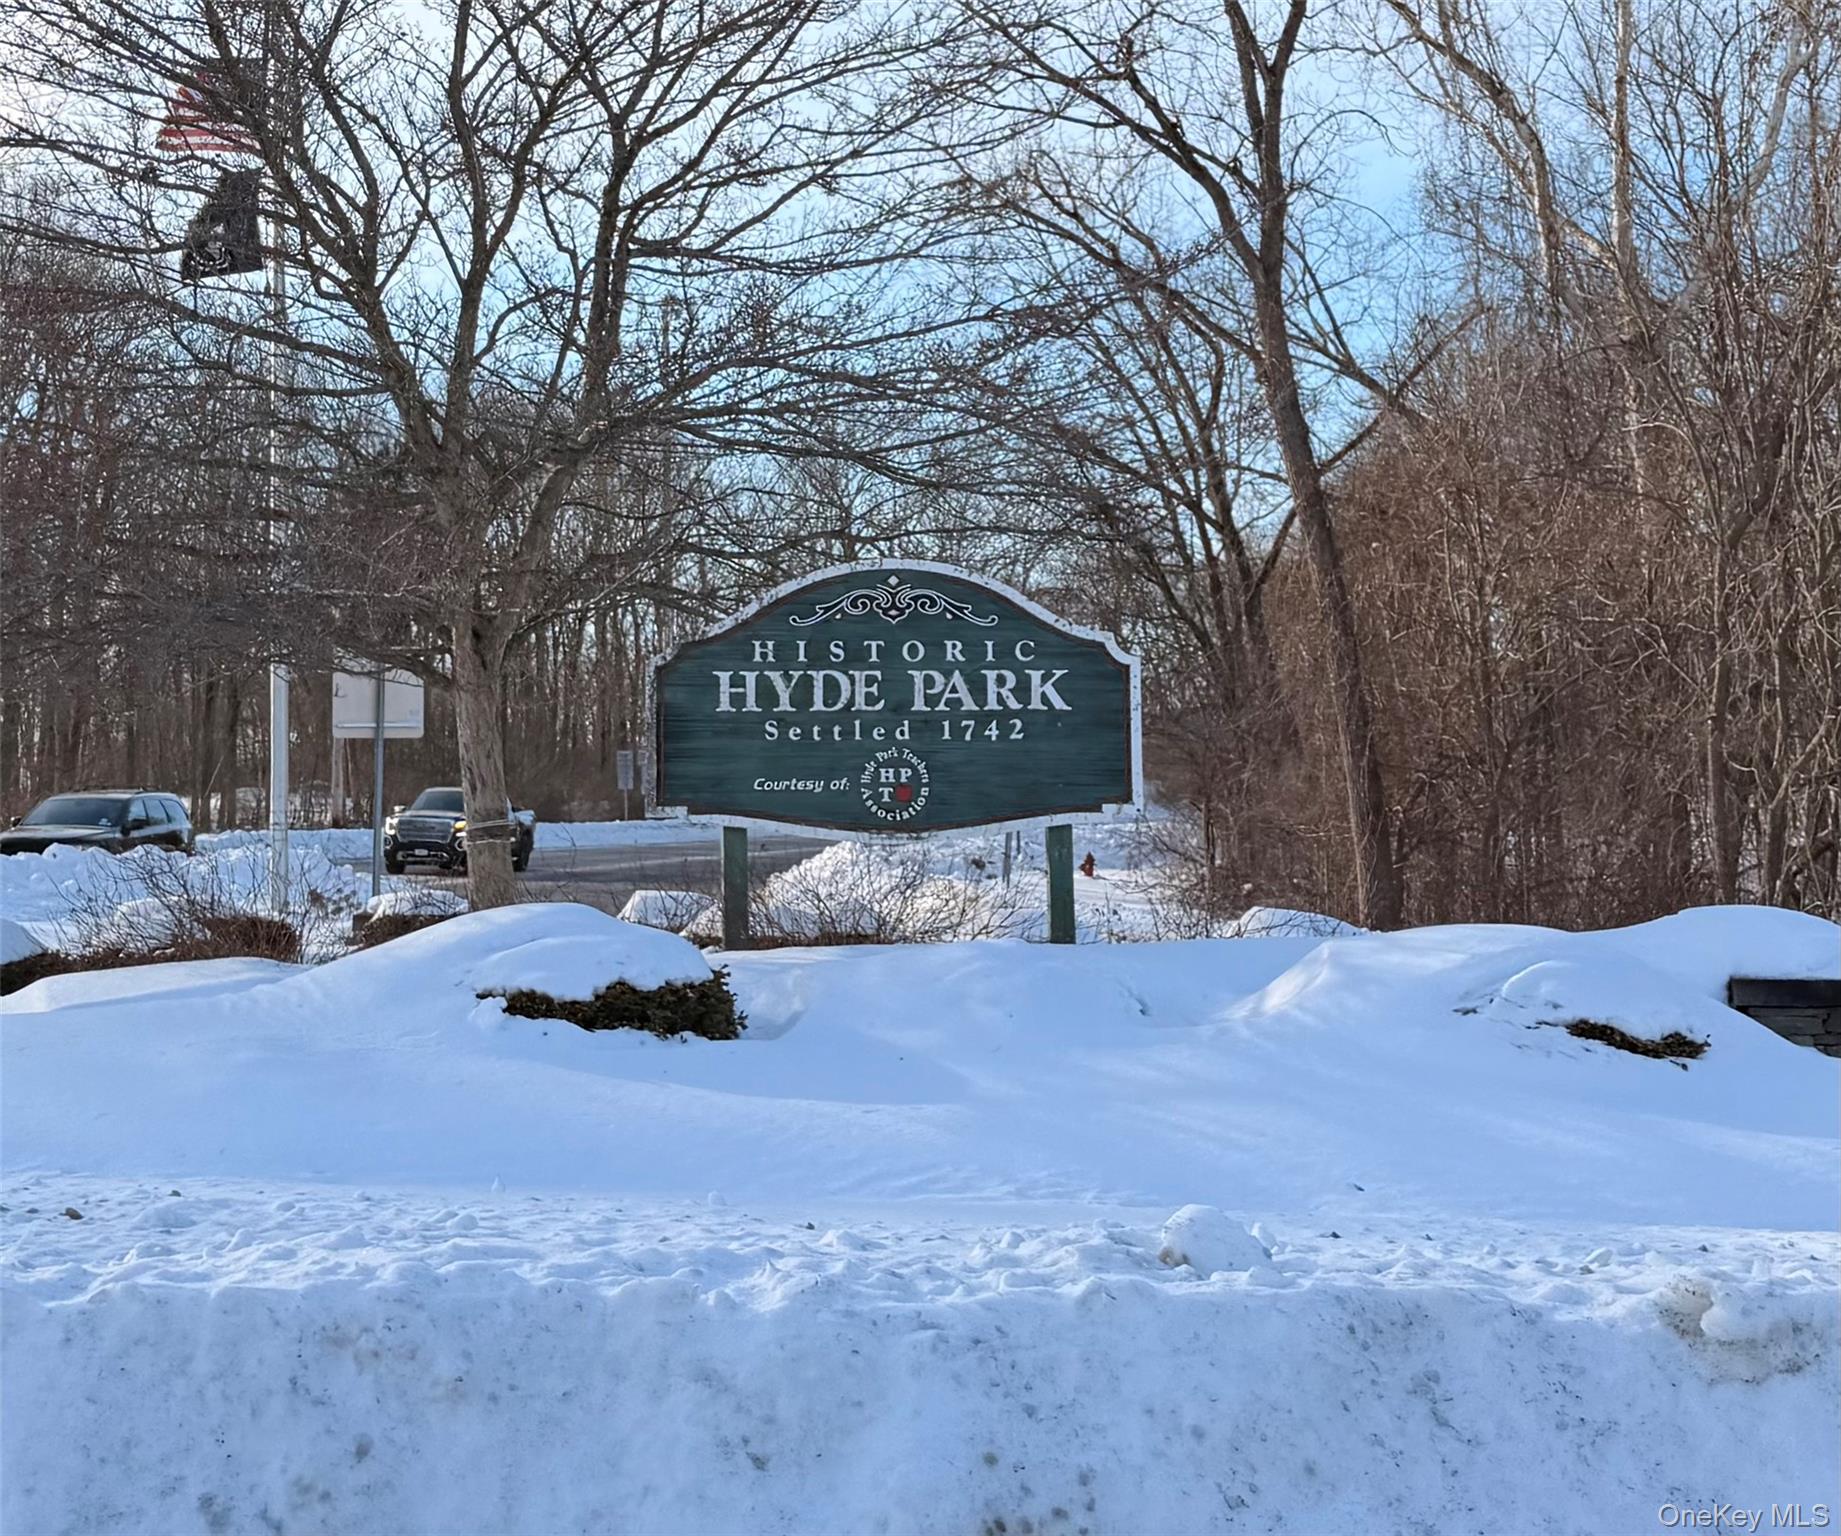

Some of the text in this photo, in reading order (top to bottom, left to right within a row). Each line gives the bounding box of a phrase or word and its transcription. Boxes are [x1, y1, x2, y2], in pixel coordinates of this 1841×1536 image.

[751, 640, 1036, 663] HISTORIC
[712, 669, 1073, 712] HYDE PARK
[764, 718, 1025, 741] Settled 1742
[875, 746, 899, 762] Park
[753, 777, 825, 793] Courtesy
[860, 787, 930, 821] Association
